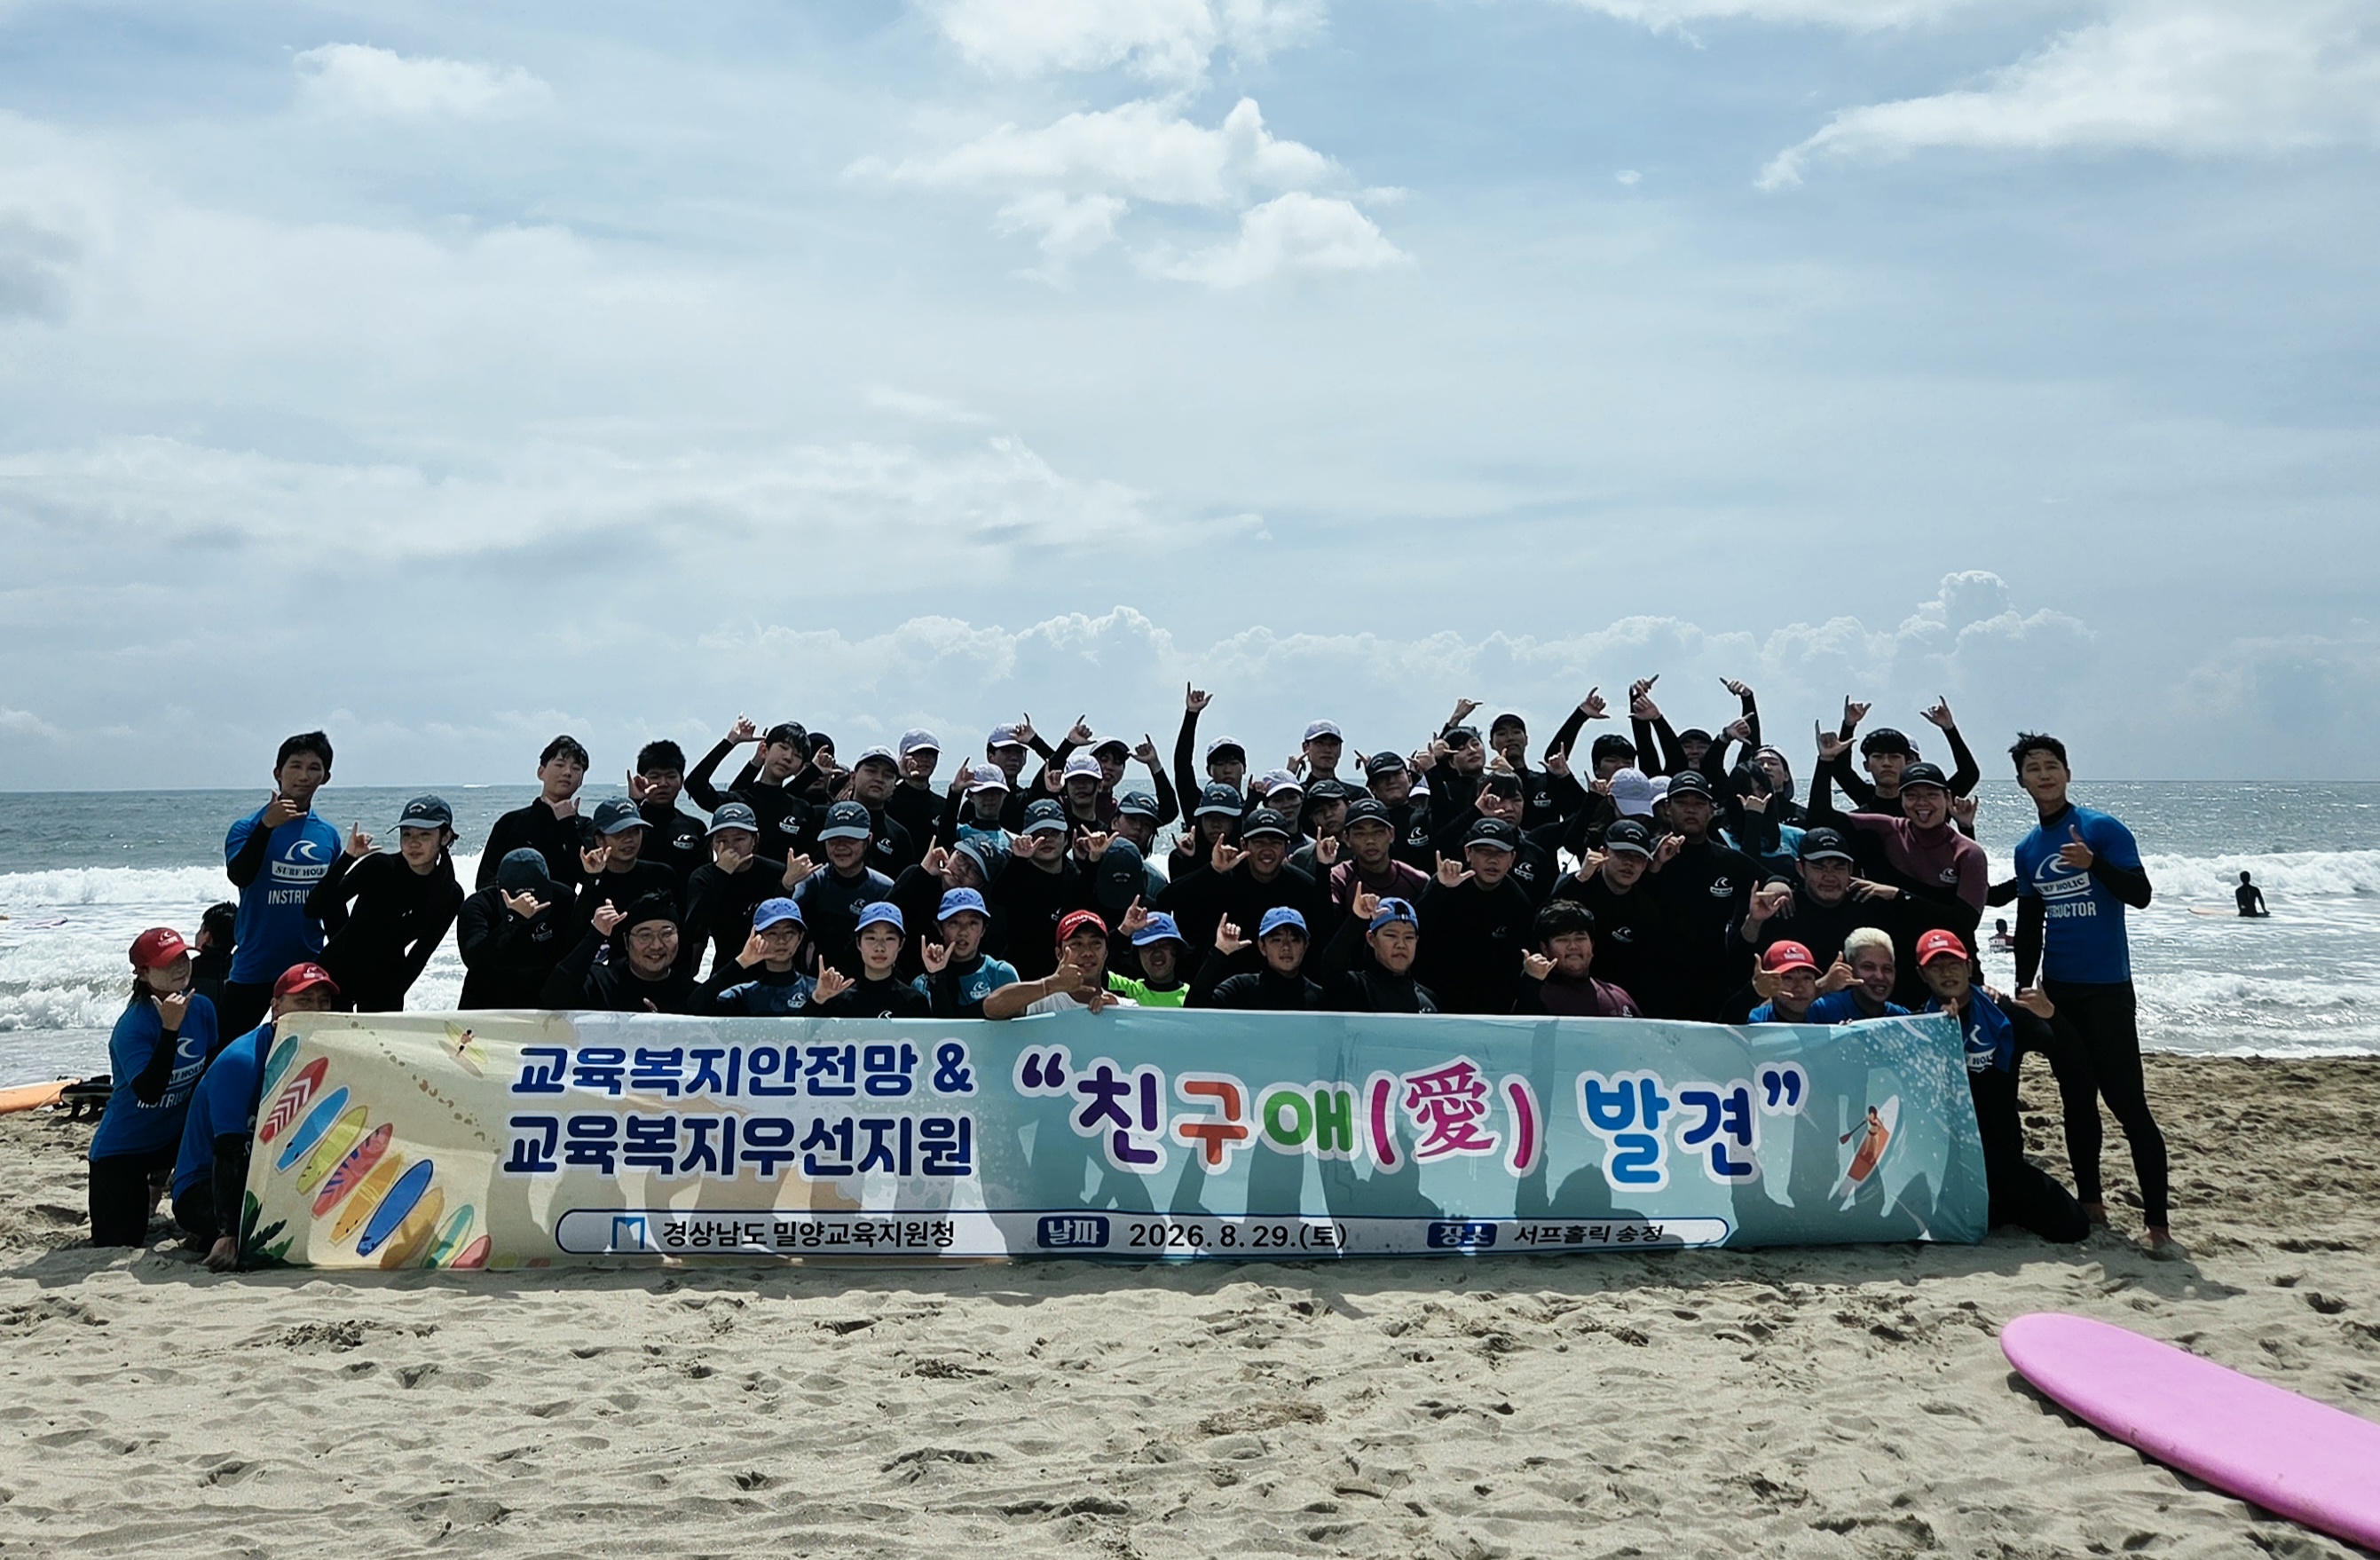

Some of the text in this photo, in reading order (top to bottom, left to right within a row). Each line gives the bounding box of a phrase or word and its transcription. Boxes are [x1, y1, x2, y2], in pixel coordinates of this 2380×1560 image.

[275, 865, 300, 876] SURF
[268, 889, 310, 905] INSTRU
[512, 1043, 973, 1097] 교육복지안전망 &
[503, 1115, 972, 1176] 교육복지우선지원
[663, 1221, 954, 1248] 경상남도 밀양교육지원청
[1048, 1219, 1100, 1245] 날짜
[1439, 1225, 1664, 1246] 장소 서프홀릭 송정
